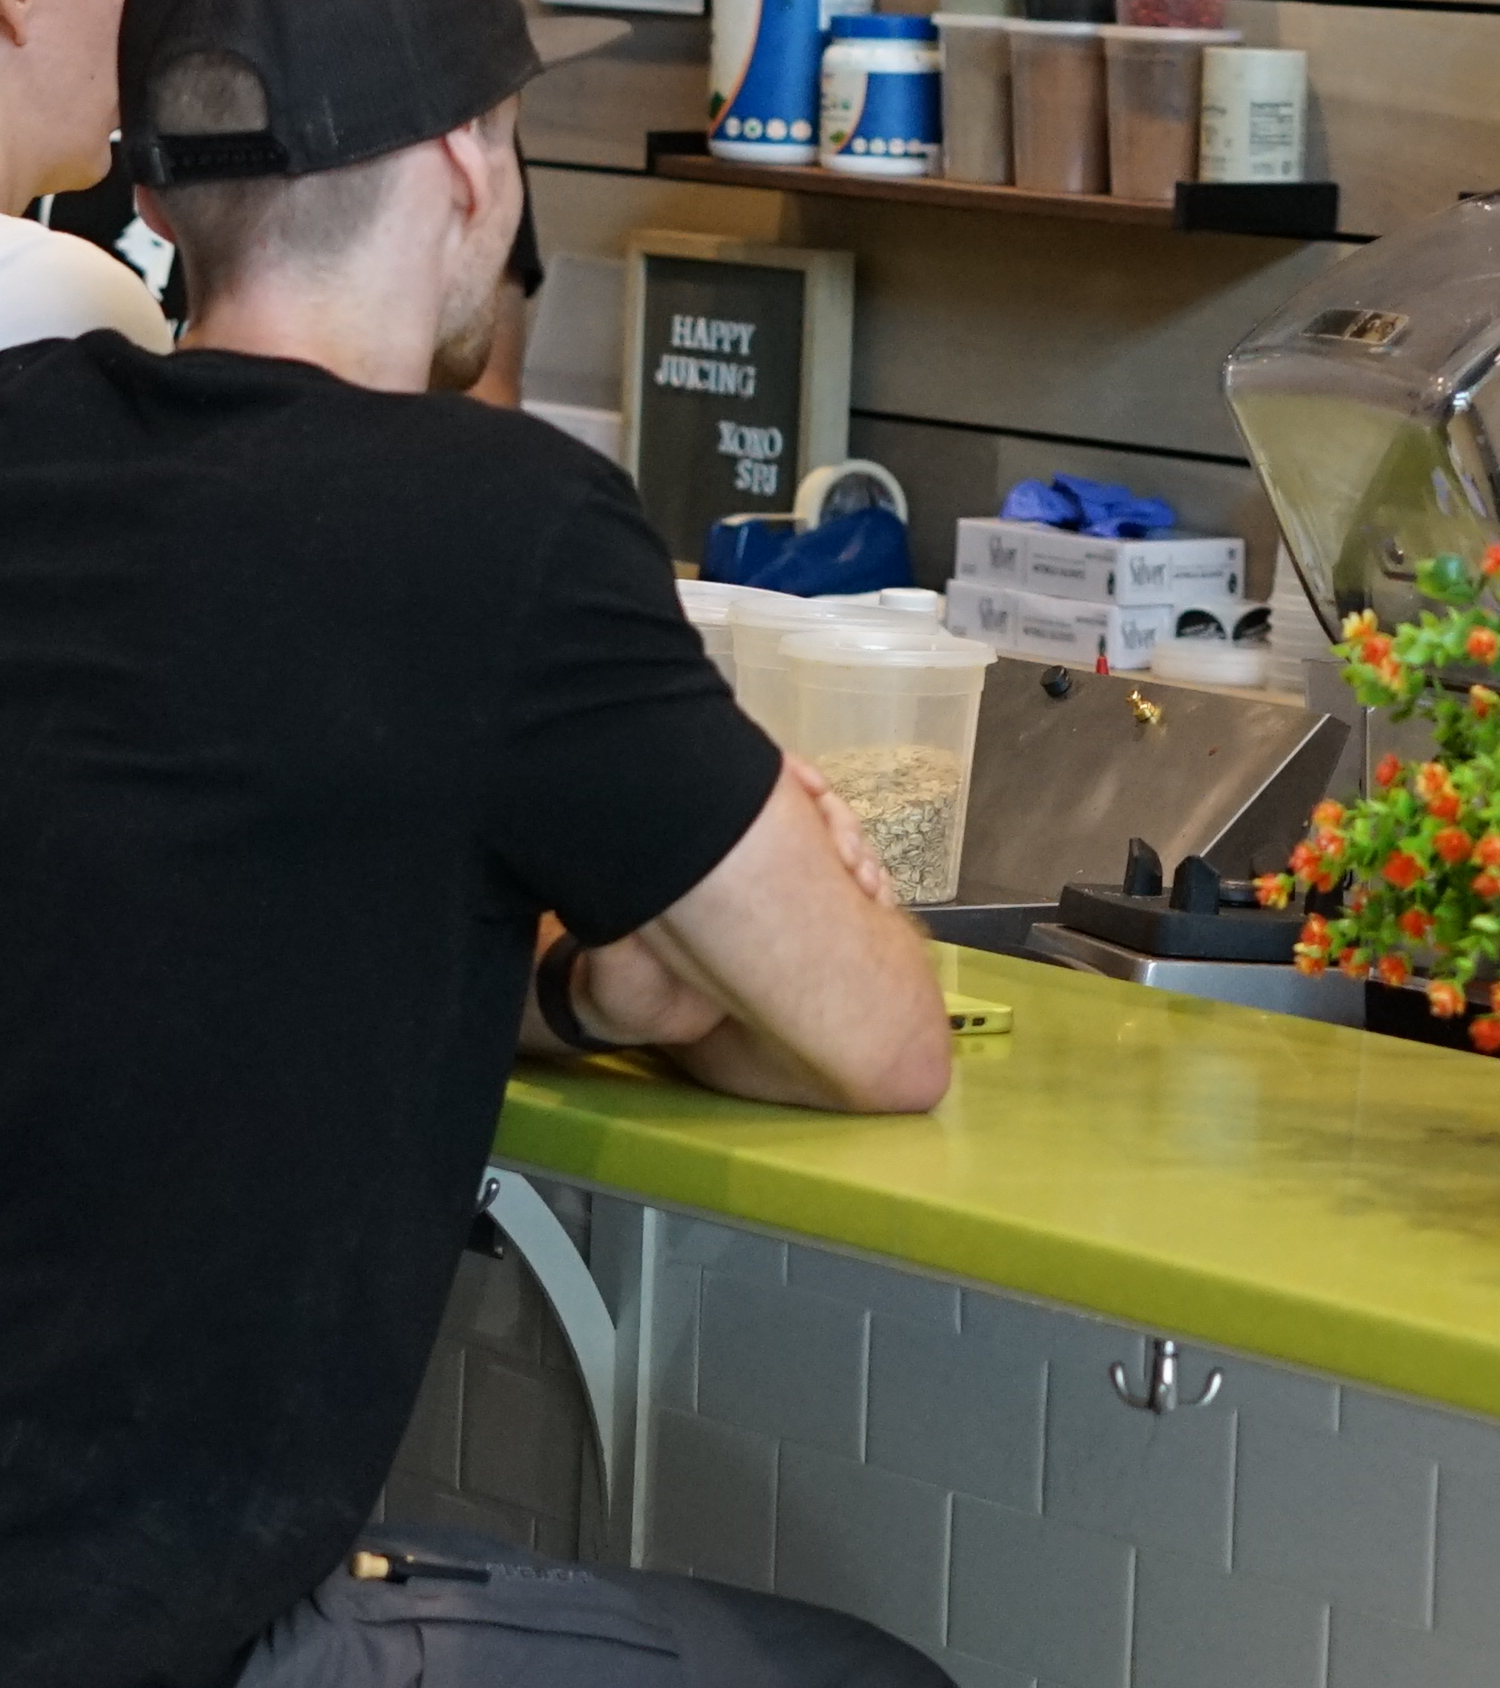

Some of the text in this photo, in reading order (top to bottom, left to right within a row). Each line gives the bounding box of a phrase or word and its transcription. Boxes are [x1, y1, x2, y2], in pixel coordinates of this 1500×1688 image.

[671, 313, 757, 356] HAPPY
[654, 352, 756, 398] JUICING
[717, 419, 783, 460] XOXO
[1130, 554, 1167, 586] Silver
